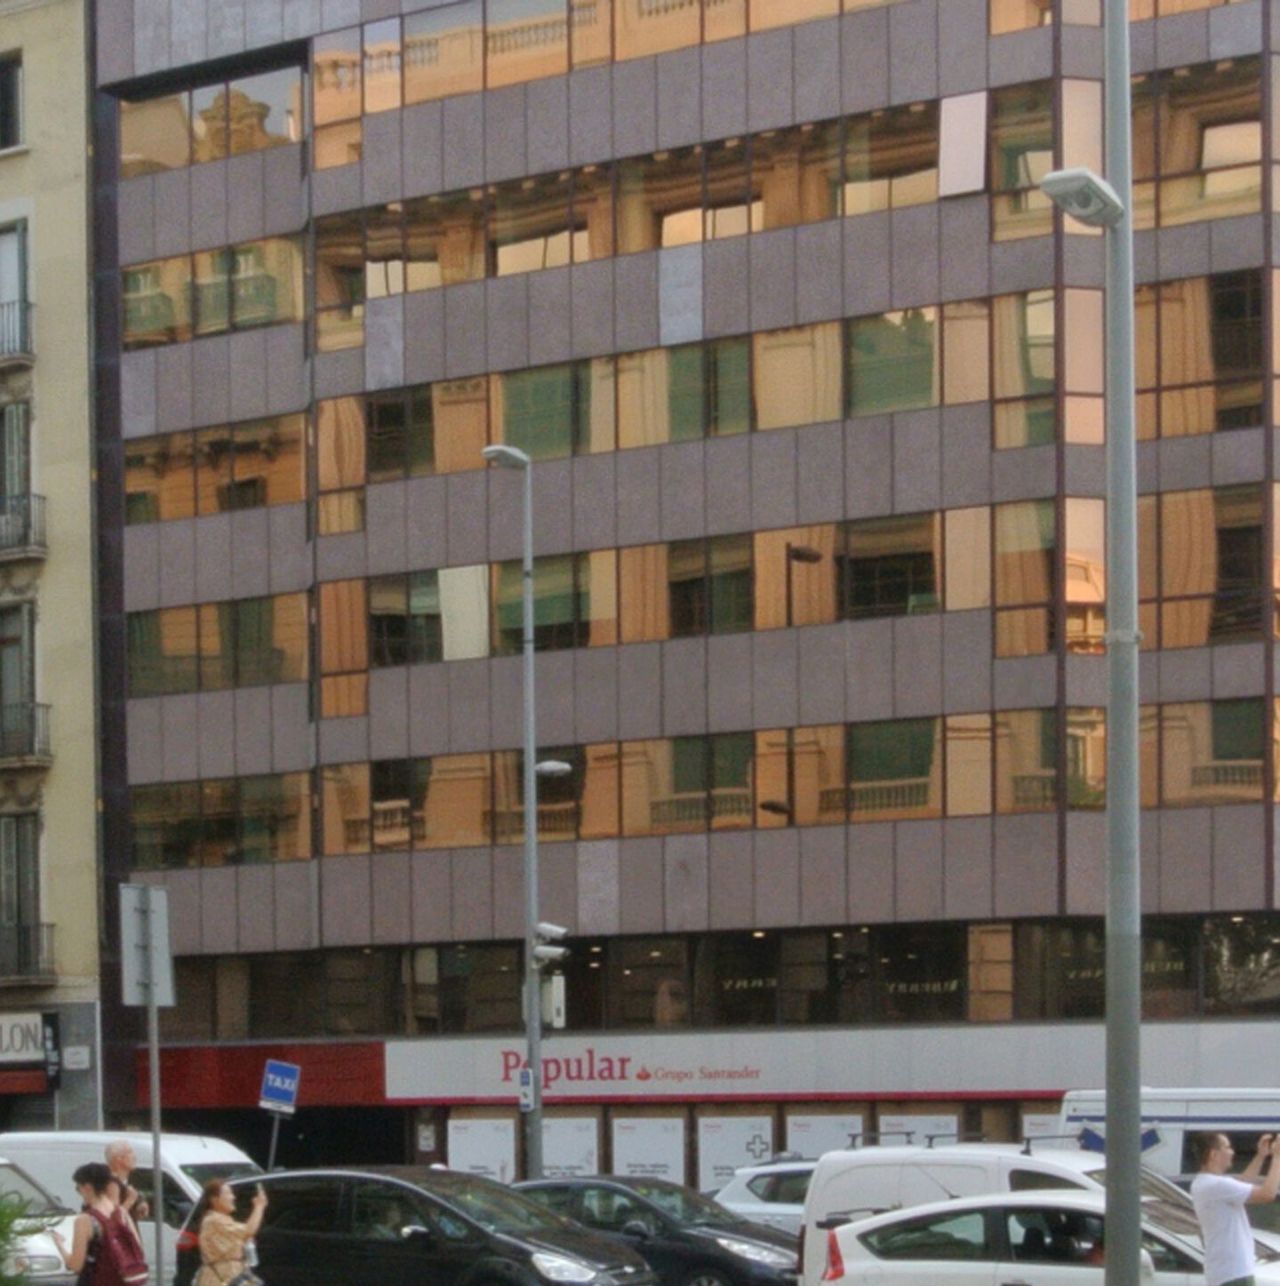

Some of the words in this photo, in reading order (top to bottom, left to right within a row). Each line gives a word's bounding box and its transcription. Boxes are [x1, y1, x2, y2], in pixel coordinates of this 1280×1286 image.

[267, 1073, 296, 1091] TAXI
[501, 1049, 631, 1089] Ppular
[654, 1067, 693, 1082] Grupo
[698, 1065, 761, 1080] Santander
